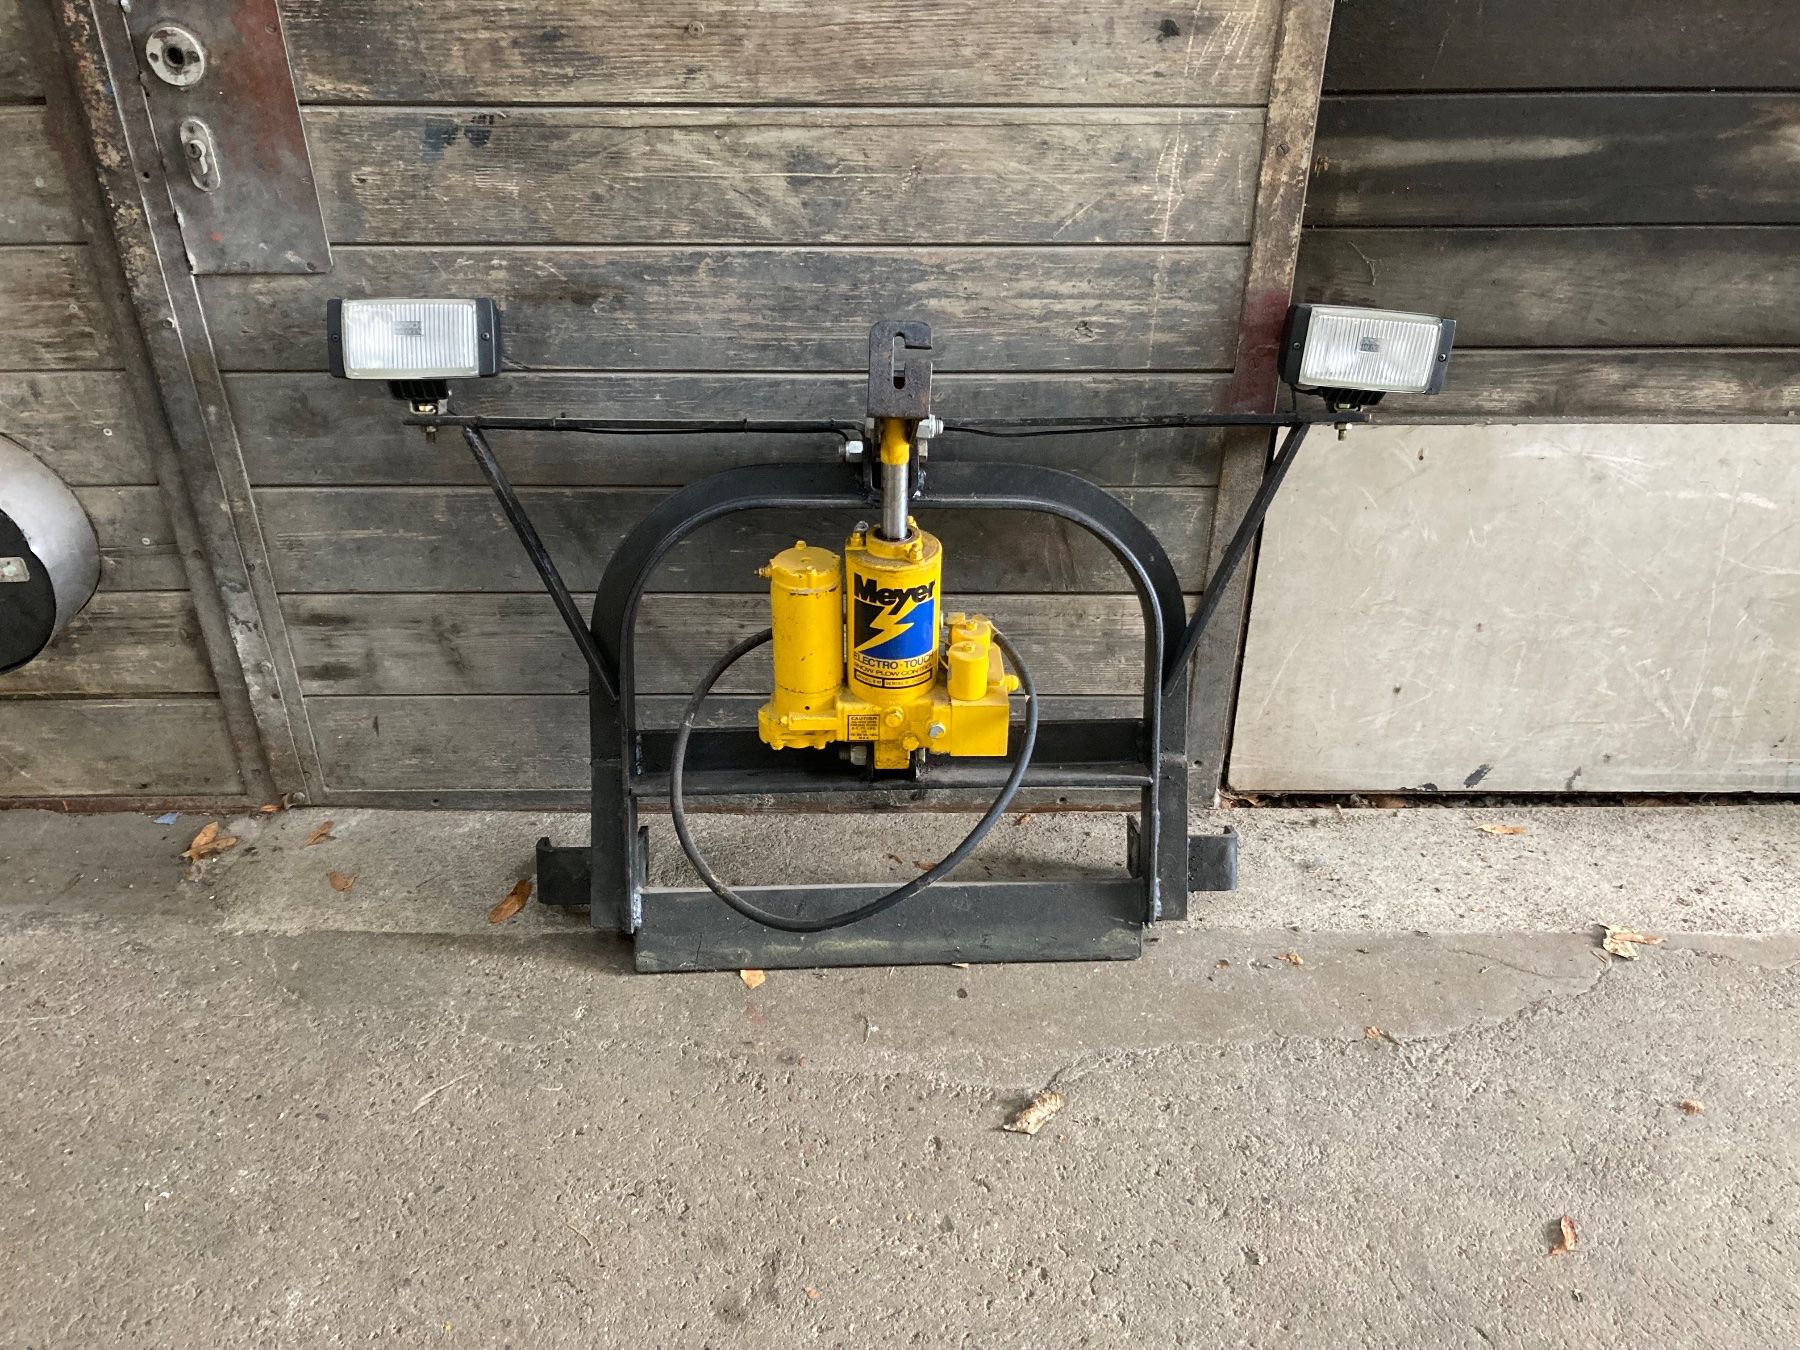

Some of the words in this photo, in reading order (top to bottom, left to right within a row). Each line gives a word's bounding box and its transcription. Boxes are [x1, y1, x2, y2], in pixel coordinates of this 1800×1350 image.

[854, 572, 936, 616] Meyer
[854, 651, 899, 670] ELECTRO
[905, 651, 934, 668] TOUCH
[875, 669, 899, 677] PLOW
